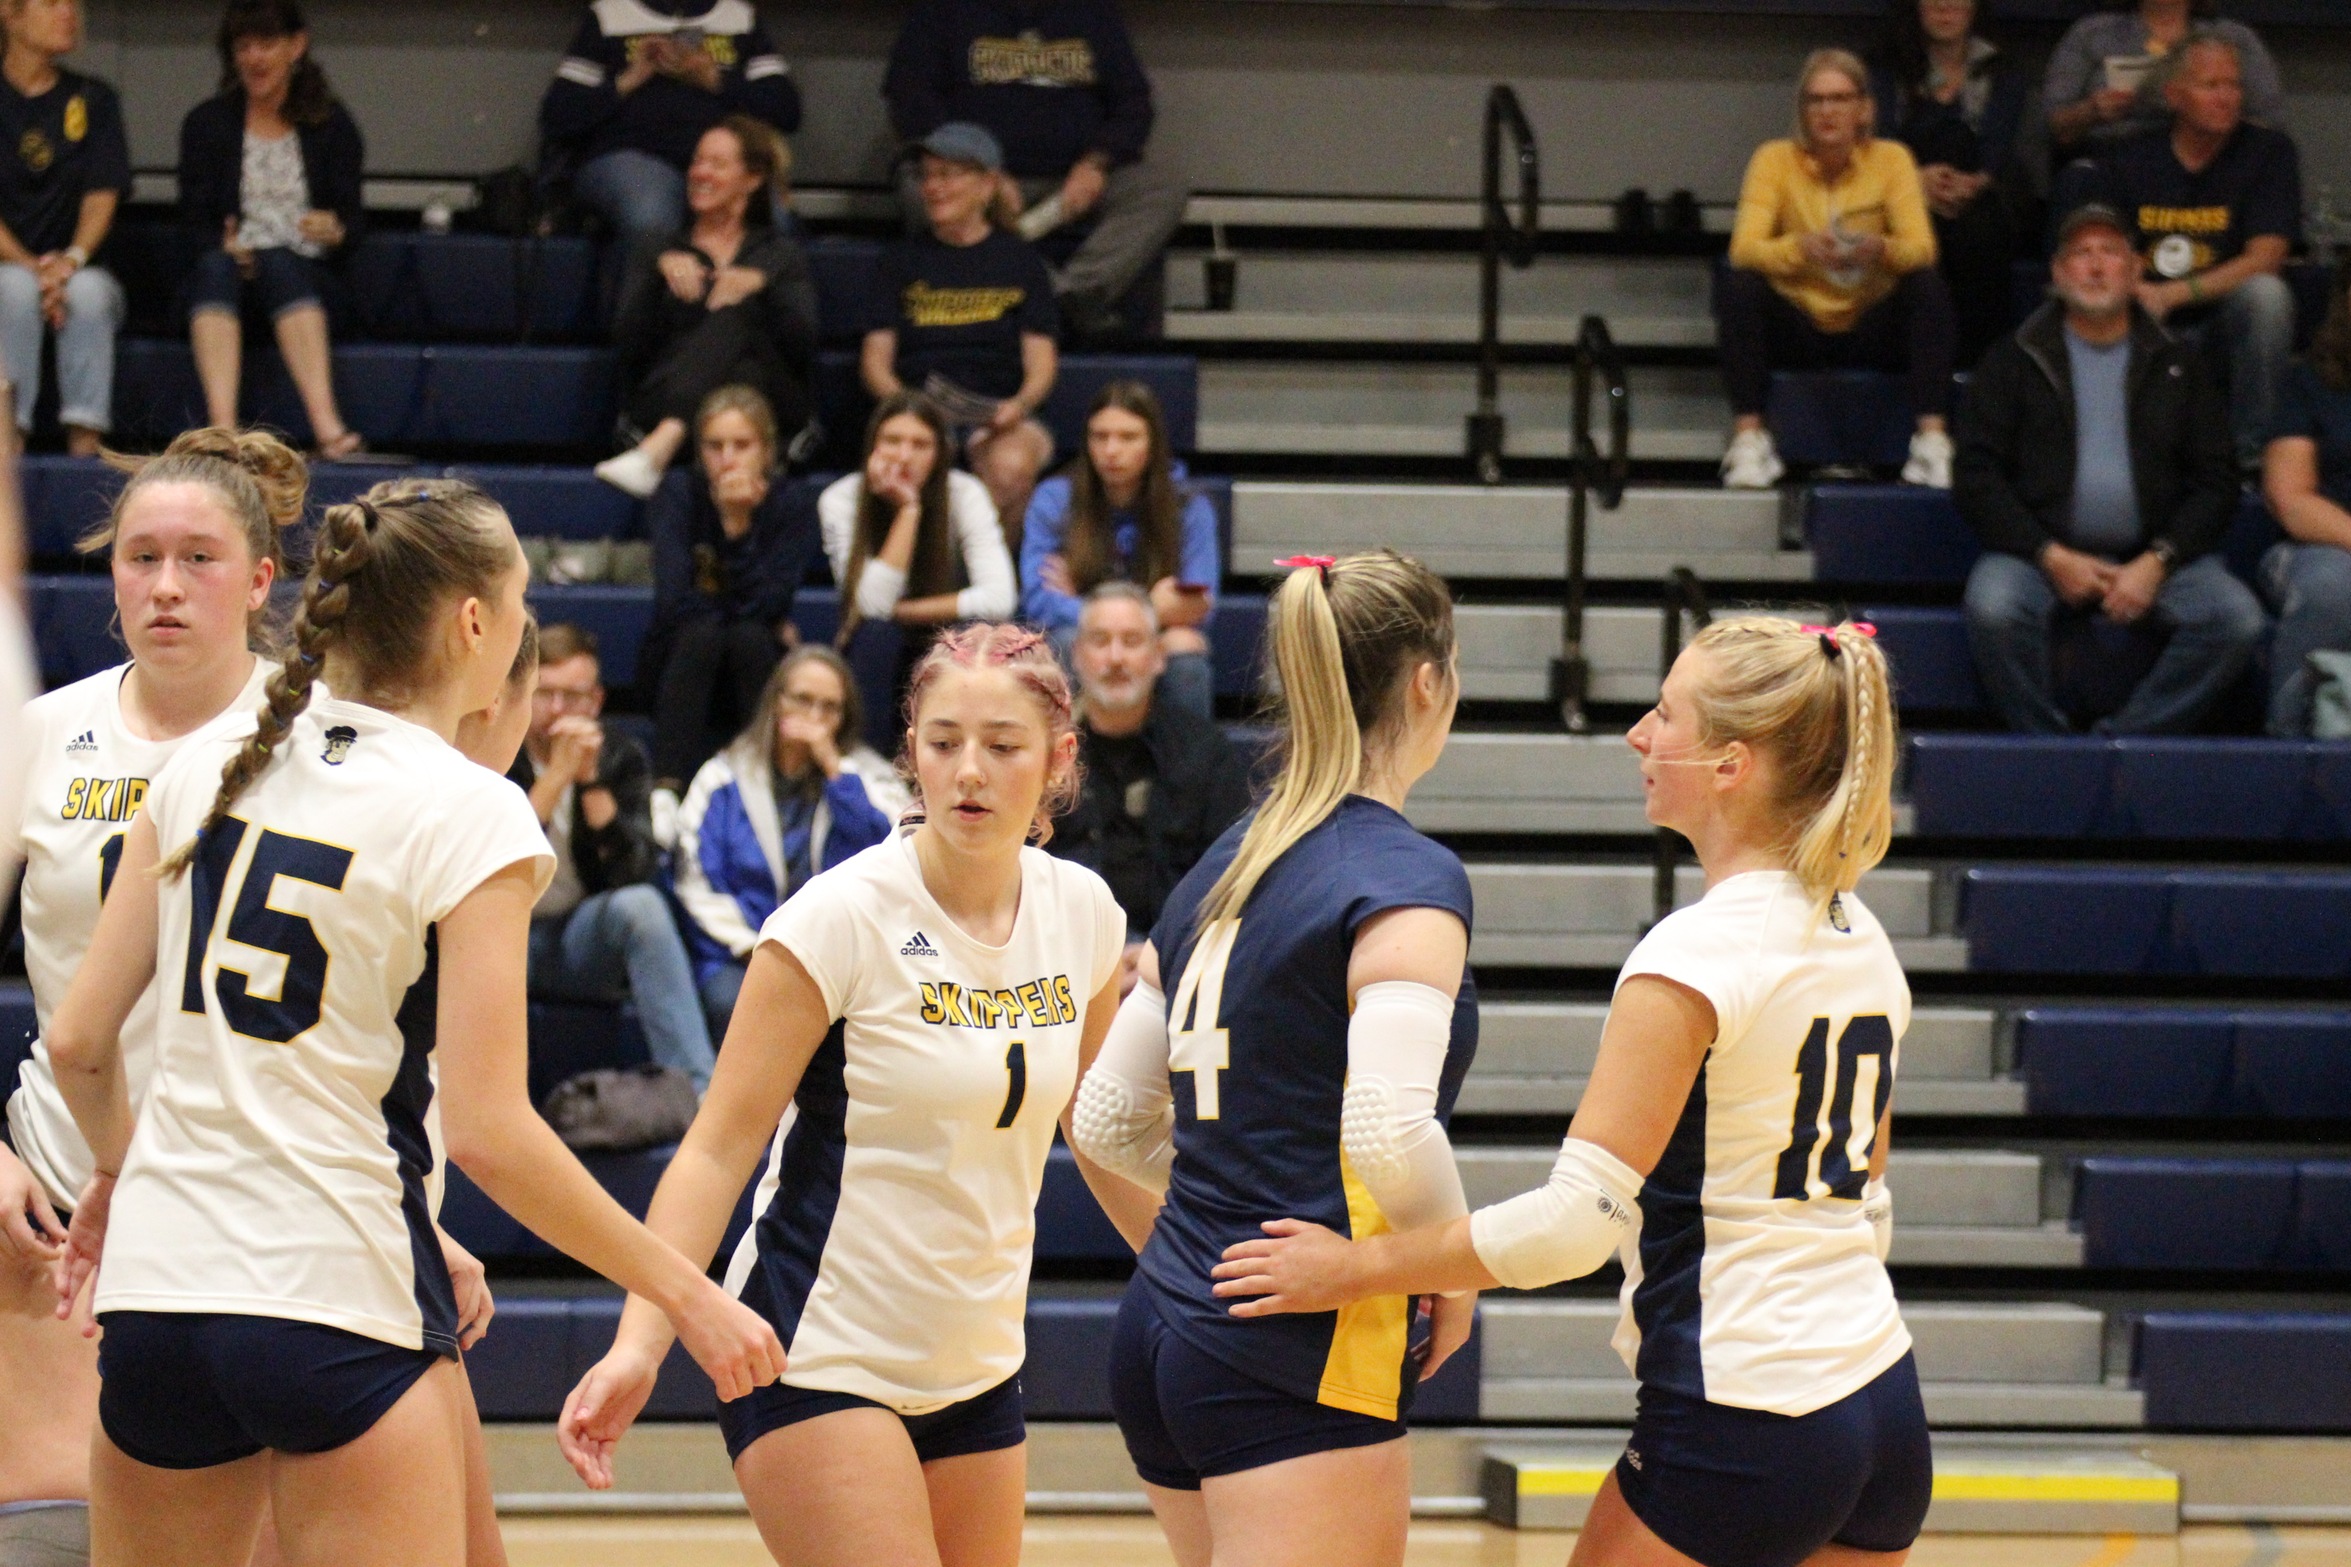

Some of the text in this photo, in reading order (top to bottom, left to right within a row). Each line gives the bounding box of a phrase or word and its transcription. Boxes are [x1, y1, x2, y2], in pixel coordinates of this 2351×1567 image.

[65, 741, 98, 751] adidas
[179, 812, 359, 1045] 15
[900, 945, 939, 957] adidas
[918, 974, 1077, 1030] SKIPPERS
[1167, 917, 1243, 1120] 4
[993, 1040, 1029, 1130] 1
[1771, 1012, 1895, 1201] 10
